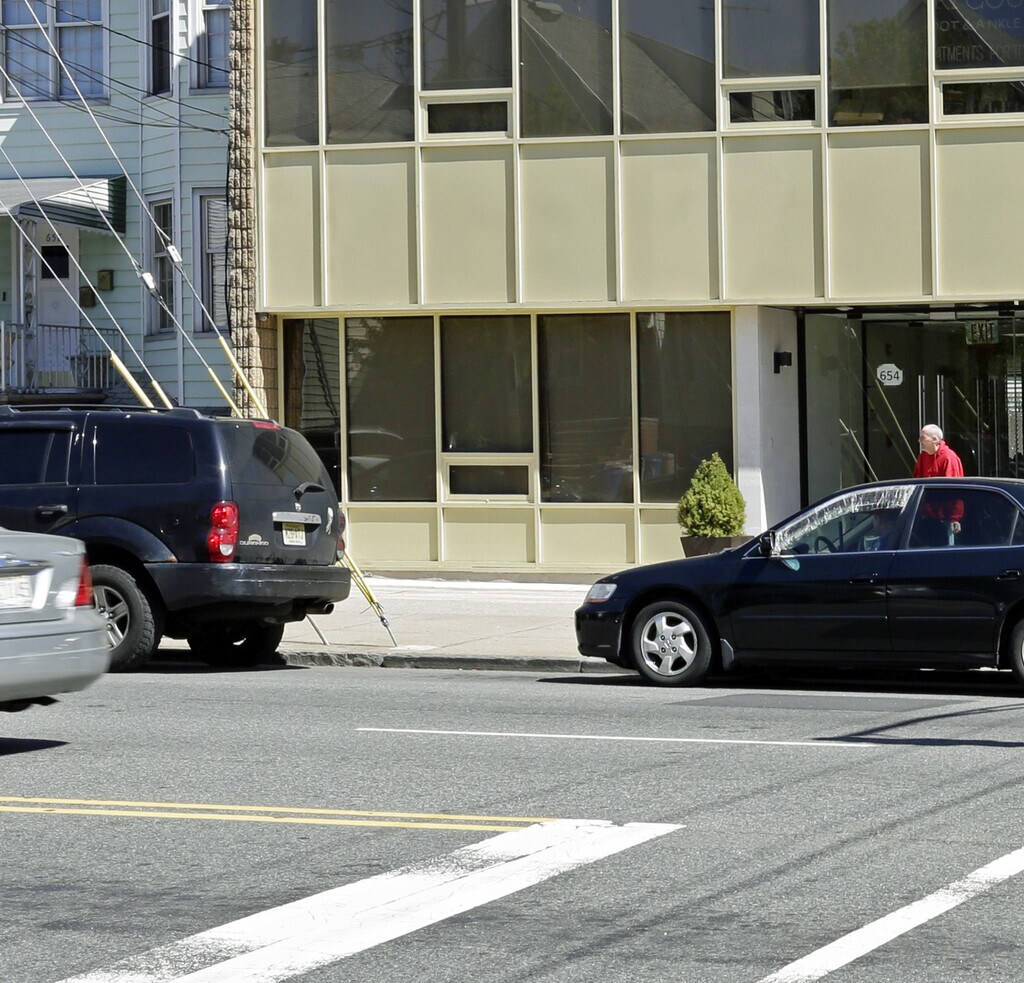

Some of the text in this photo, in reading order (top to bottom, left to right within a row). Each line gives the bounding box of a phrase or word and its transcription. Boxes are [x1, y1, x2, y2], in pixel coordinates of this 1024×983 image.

[975, 17, 1022, 30] ANKLE
[971, 322, 994, 342] EXIT
[879, 370, 900, 381] 654
